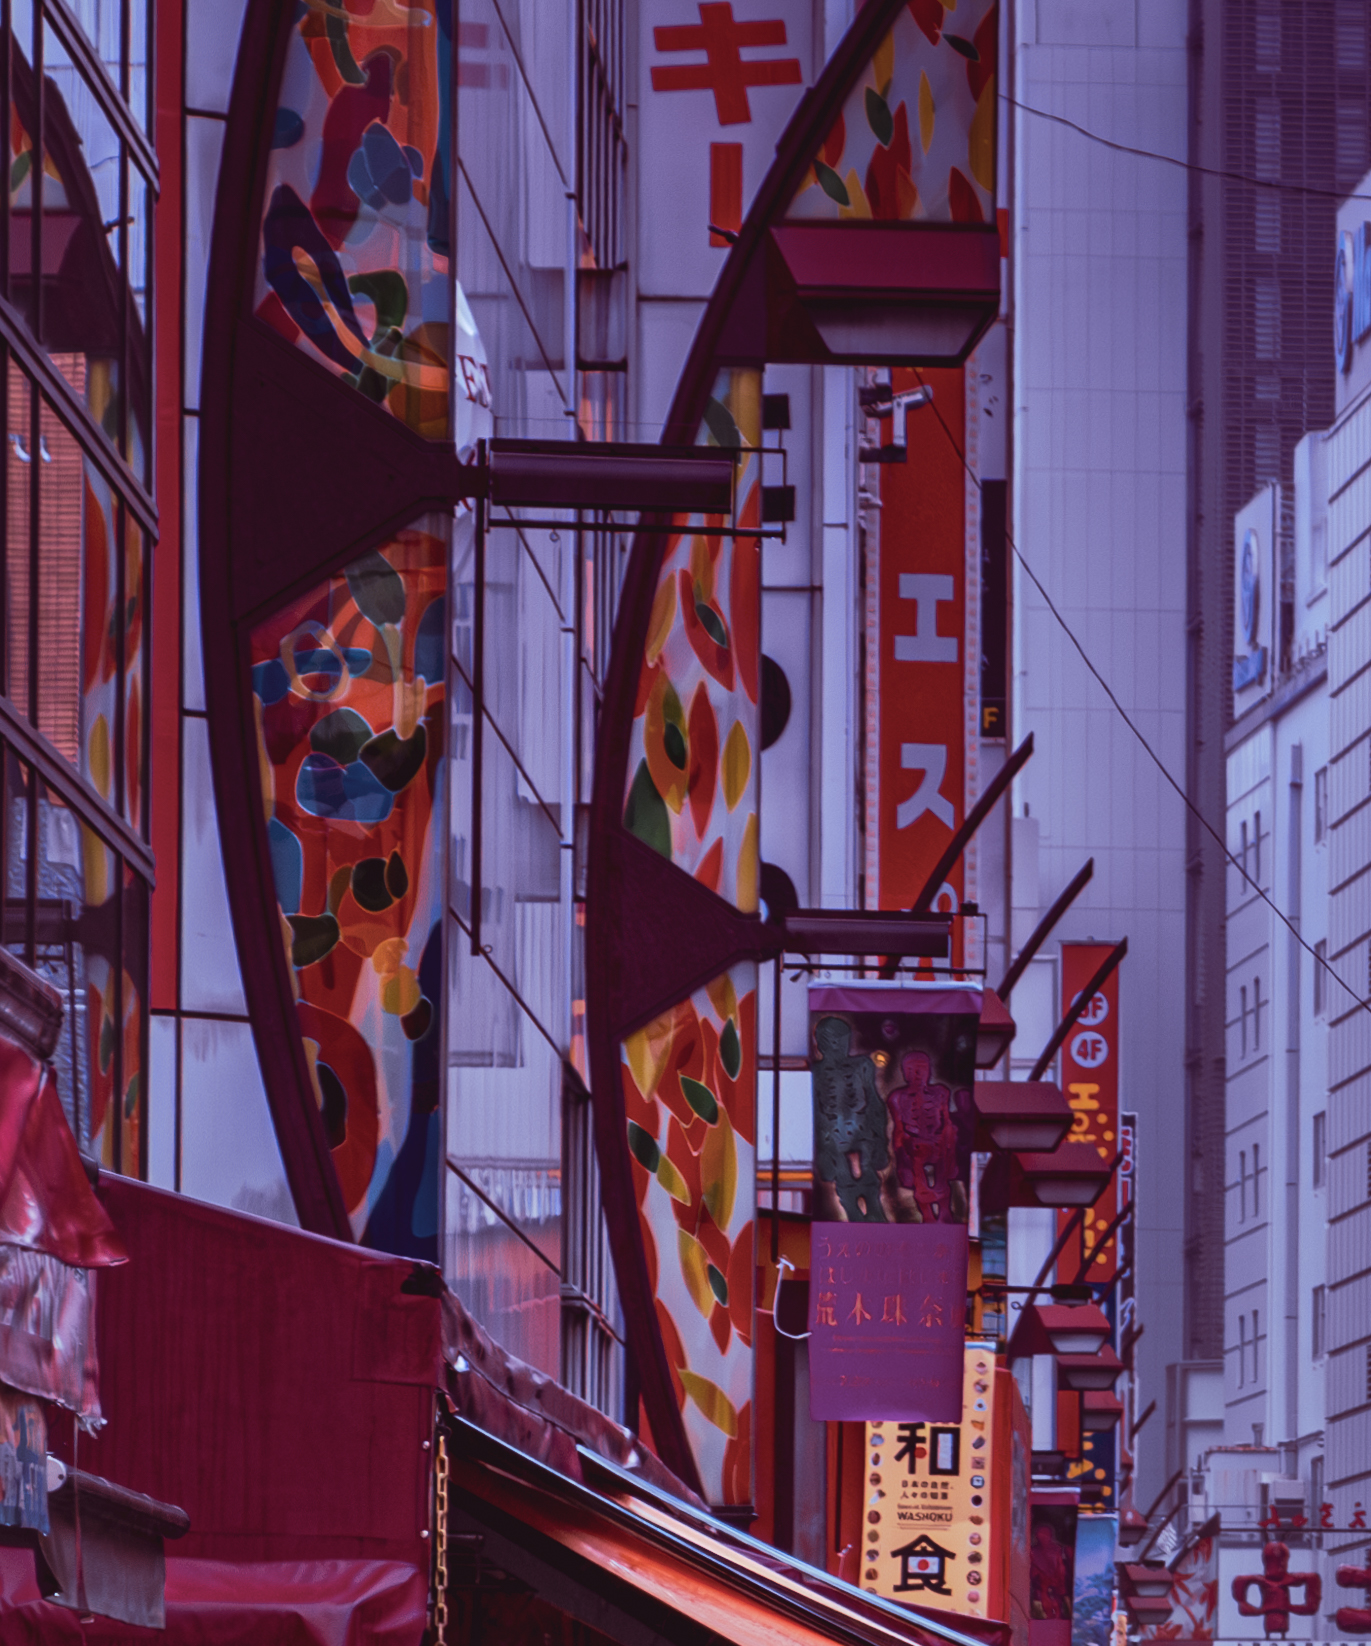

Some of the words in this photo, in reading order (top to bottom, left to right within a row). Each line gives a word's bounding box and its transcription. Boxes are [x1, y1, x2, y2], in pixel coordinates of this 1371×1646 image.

[1073, 1040, 1104, 1062] 4F
[897, 1511, 953, 1522] WASHOKU
[890, 1534, 956, 1596] 食
